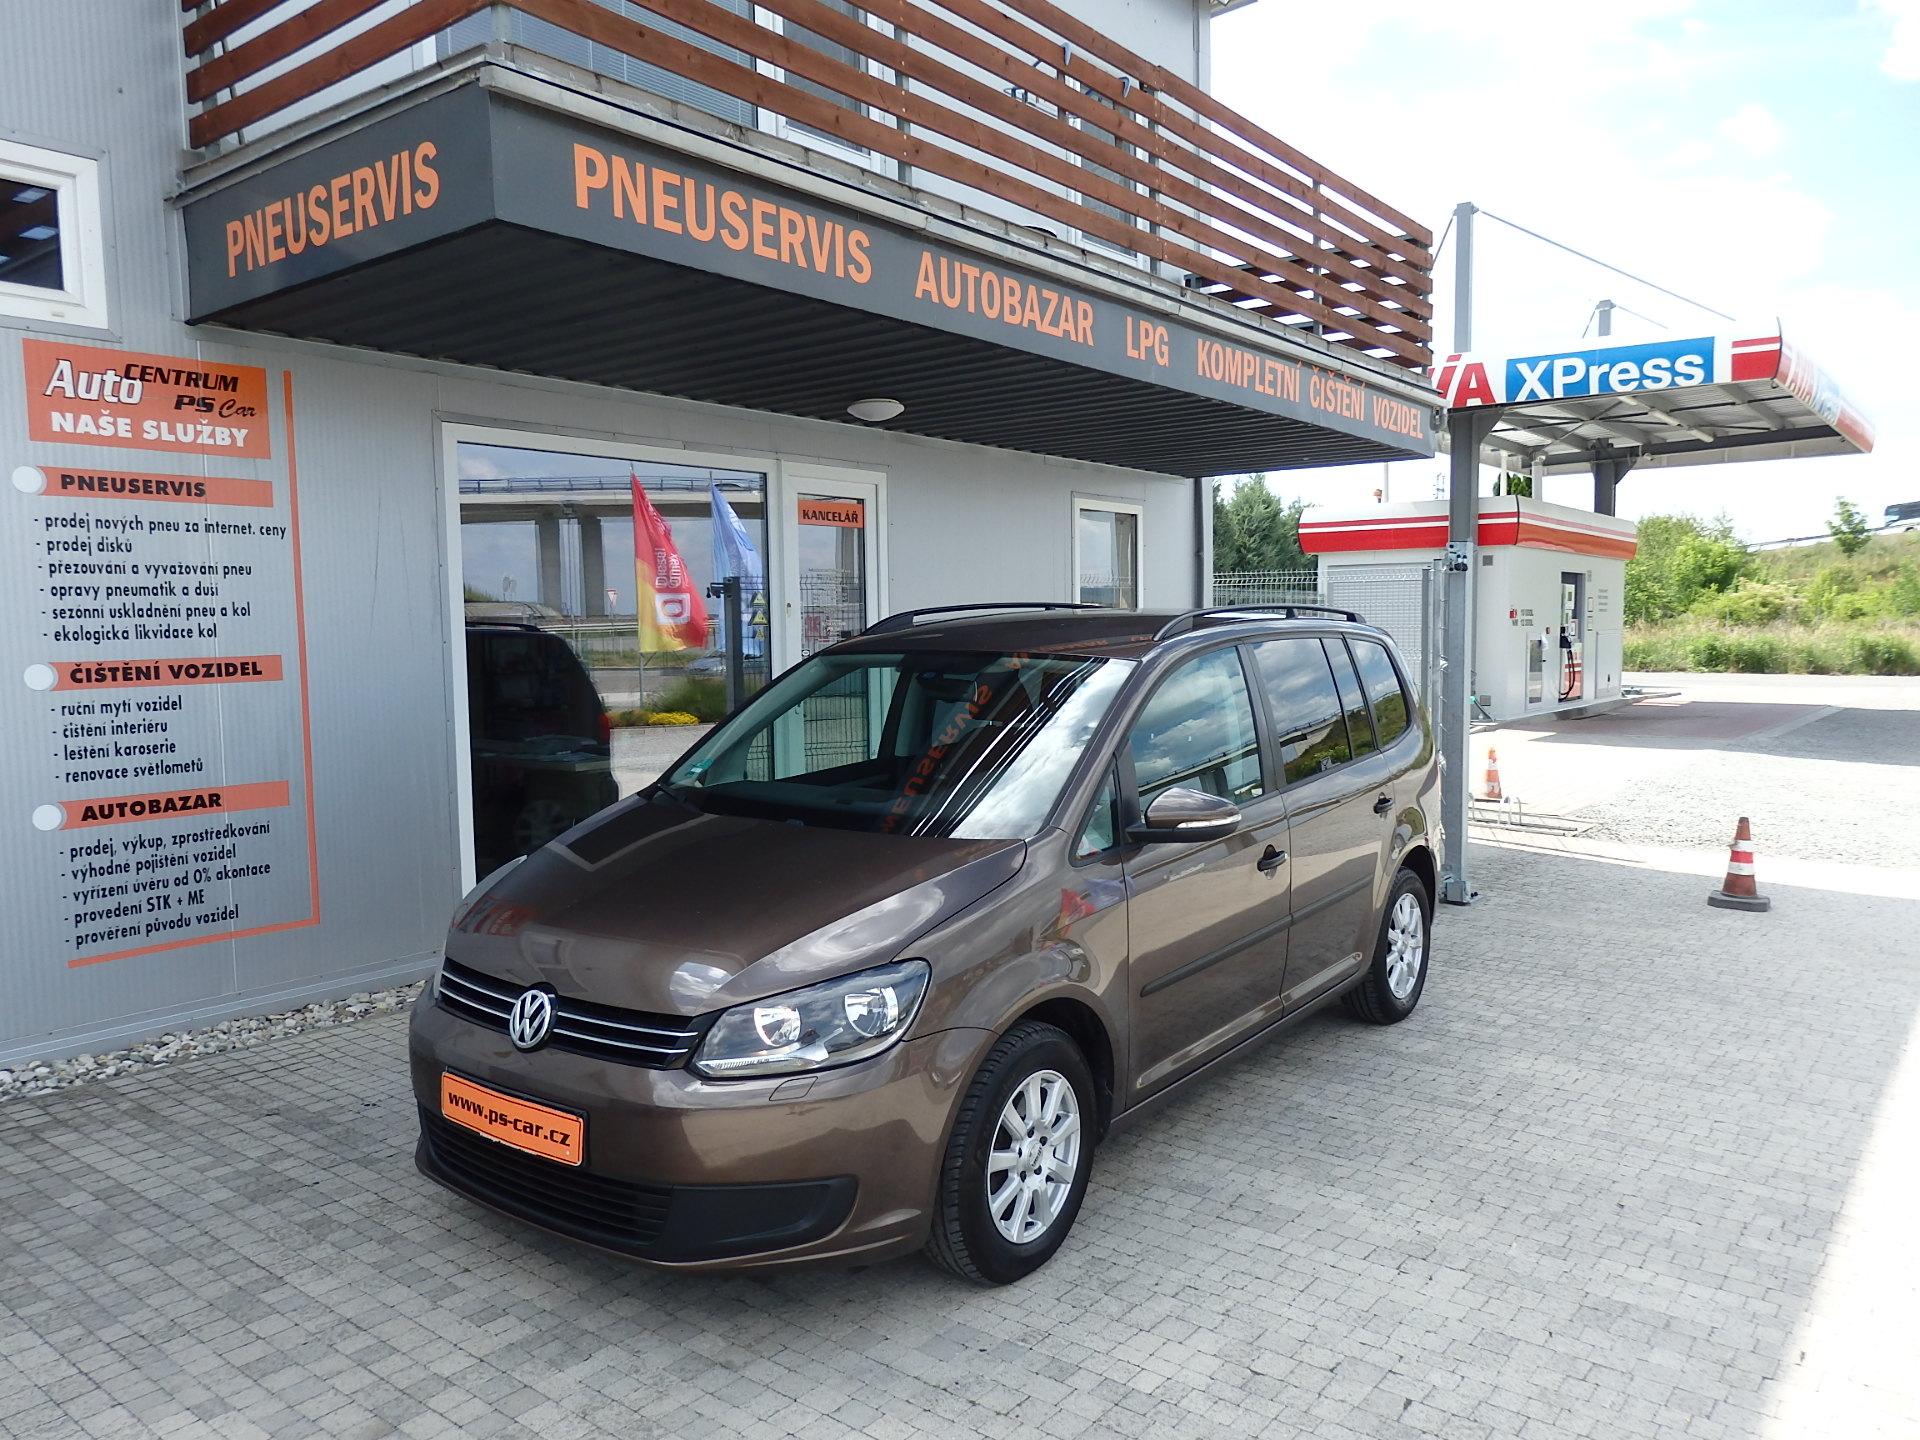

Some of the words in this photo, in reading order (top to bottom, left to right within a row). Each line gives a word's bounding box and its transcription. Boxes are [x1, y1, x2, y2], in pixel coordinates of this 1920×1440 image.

[226, 141, 441, 279] PNEUSERVIS
[571, 142, 872, 285] PNEUSERVIS
[915, 250, 1095, 348] AUTOBAZAR
[1126, 316, 1170, 368] LPG
[43, 358, 143, 405] Auto
[124, 362, 239, 393] CENTRUM
[1197, 338, 1301, 403] KOMPLETNÍ
[1309, 365, 1366, 422] ČIŠTĚNÍ
[1372, 401, 1423, 440] VOZIDEL
[1514, 353, 1705, 400] XPress
[174, 394, 216, 413] PS
[218, 398, 257, 419] Car
[50, 408, 133, 439] NAŠE
[142, 418, 249, 448] SLUŽBY
[60, 473, 206, 498] PNEUSERVIS
[45, 512, 91, 533] prodej
[95, 514, 144, 534] nových
[149, 519, 180, 534] pneu
[184, 520, 200, 533] za
[259, 524, 287, 539] ceny
[802, 509, 859, 523] KANCELÁŘ
[46, 536, 92, 556] prodej
[131, 564, 140, 575] a
[222, 563, 252, 579] pneu
[50, 584, 101, 600] opravy
[106, 580, 177, 600] pneumatik
[182, 585, 189, 596] a
[186, 605, 216, 620] pneu
[220, 606, 228, 617] a
[232, 601, 251, 618] kol
[54, 625, 129, 644] ekologická
[135, 625, 193, 641] likvidace
[197, 623, 217, 638] kol
[70, 660, 161, 684] ČIŠTĚNÍ
[168, 661, 263, 680] VOZIDEL
[61, 700, 95, 717] ruční
[136, 695, 183, 713] vozidel
[63, 723, 107, 739] čištění
[111, 719, 168, 736] interiéru
[64, 744, 110, 761] leštění
[114, 739, 176, 758] karoserie
[65, 765, 129, 783] renovace
[80, 792, 222, 822] AUTOBAZAR
[70, 837, 118, 862] prodej,
[193, 843, 237, 863] vozidel
[174, 870, 189, 887] od
[193, 867, 212, 884] 0%
[216, 863, 271, 882] akontace
[74, 904, 143, 928] provedení
[146, 893, 172, 913] STK
[187, 889, 205, 905] ME
[195, 903, 239, 925] vozidel
[448, 1092, 571, 1147] www.ps-car.cz
